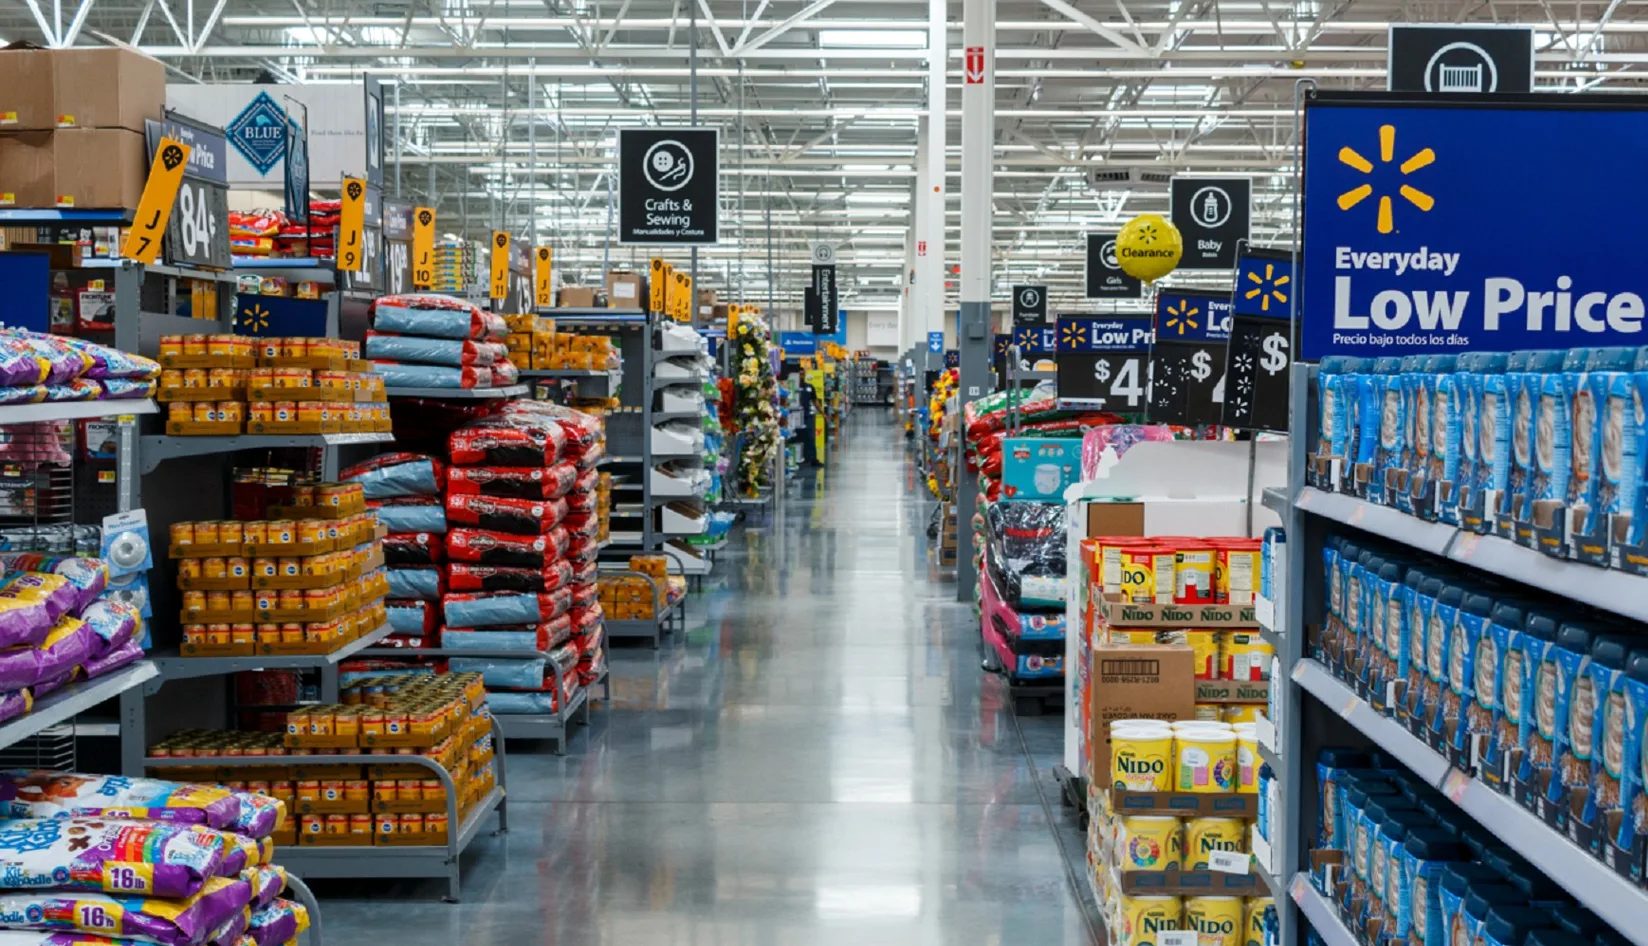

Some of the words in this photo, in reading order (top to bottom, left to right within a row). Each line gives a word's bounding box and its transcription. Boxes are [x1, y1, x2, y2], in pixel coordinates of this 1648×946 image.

[244, 127, 282, 139] BLUE
[196, 143, 214, 169] Price
[645, 198, 680, 211] Crafts
[682, 199, 692, 211] &
[145, 210, 161, 230] J
[646, 213, 690, 228] Sewing
[347, 230, 356, 246] J
[632, 228, 675, 236] Manualidades
[136, 236, 152, 256] 7
[1198, 239, 1223, 252] Baby
[345, 252, 355, 267] 9
[420, 251, 428, 265] J
[1121, 248, 1175, 258] Clearance
[1335, 246, 1460, 276] Everyday
[416, 270, 430, 282] 10
[497, 269, 503, 281] J
[1106, 276, 1122, 285] Girls
[495, 284, 504, 296] 11
[541, 279, 547, 290] J
[655, 287, 660, 297] J
[539, 294, 548, 304] 12
[653, 301, 661, 310] 13
[821, 269, 831, 330] Entertainment
[1334, 275, 1470, 331] Low
[1484, 275, 1646, 333] Price
[1092, 322, 1123, 330] Everyday
[1092, 329, 1129, 344] Low
[1332, 333, 1367, 345] Precio
[1369, 333, 1393, 347] bajo
[1396, 333, 1427, 345] todos
[1429, 333, 1445, 345] los
[1446, 333, 1469, 345] días
[1260, 332, 1289, 376] $
[1122, 609, 1153, 621] NIDO
[1161, 609, 1193, 621] NIDO
[1200, 609, 1232, 621] NIDO
[1197, 686, 1229, 699] NIDO
[1236, 687, 1268, 699] NIDO
[1117, 755, 1164, 774] NIDO
[5, 866, 22, 877] Kit
[110, 868, 134, 889] 16
[135, 878, 145, 889] lb
[81, 906, 104, 927] 16
[1187, 915, 1233, 934] NIDO
